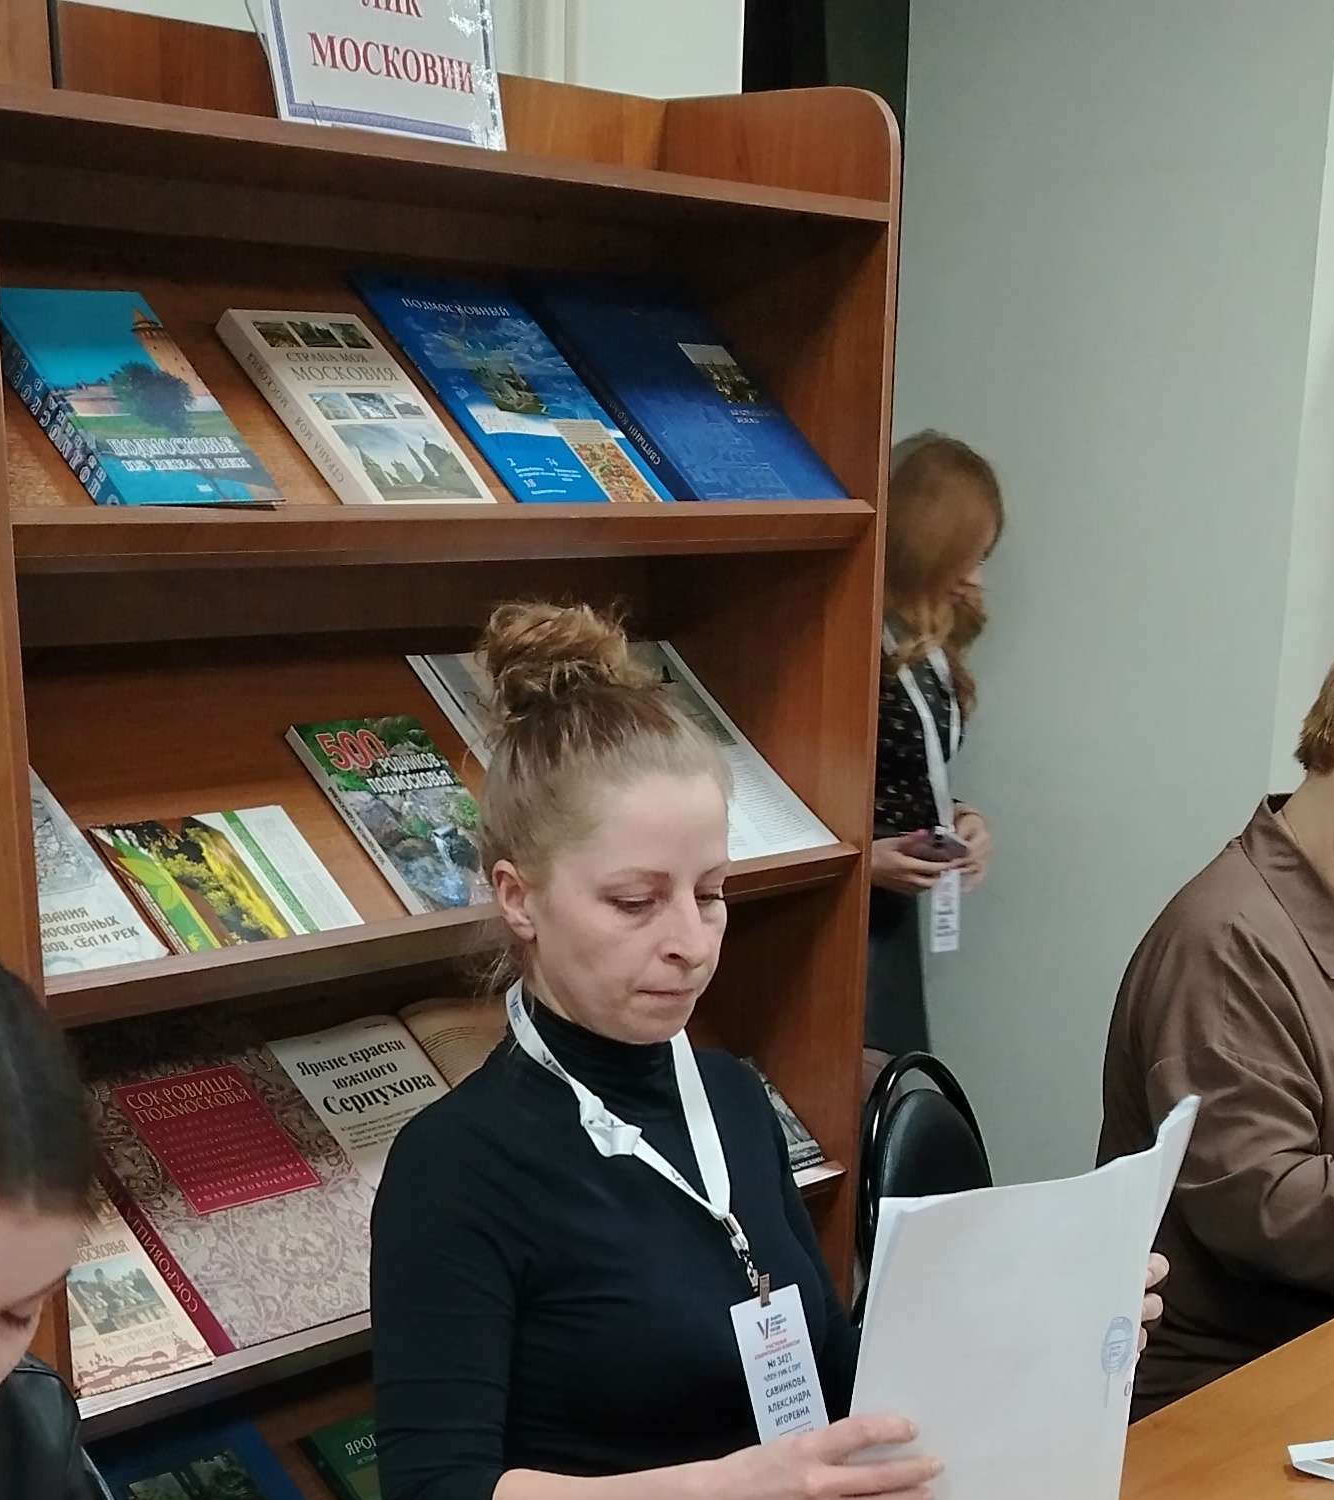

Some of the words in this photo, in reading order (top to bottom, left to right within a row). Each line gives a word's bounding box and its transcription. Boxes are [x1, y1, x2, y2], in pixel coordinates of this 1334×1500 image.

[308, 32, 475, 94] МОСКОВИИ
[286, 351, 338, 364] СТРАНА
[341, 353, 369, 364] МОЯ
[291, 366, 400, 382] МОСКОВИЯ
[315, 728, 390, 771] 500
[378, 751, 441, 774] РОДНИКОВ
[366, 770, 455, 795] ПОДМОСКОВЬЯ
[74, 933, 98, 950] СЁЛ
[101, 933, 110, 946] И
[111, 926, 140, 943] РЕК
[296, 1055, 349, 1077] Яркие
[351, 1039, 406, 1064] краски
[332, 1062, 398, 1089] южного
[126, 1075, 243, 1110] СОКРОВИЩА
[323, 1073, 437, 1116] Серпухова
[135, 1090, 252, 1124] ПОДМОСКОВЬЯ
[765, 1375, 807, 1398] САВИНКОВА
[768, 1389, 812, 1414] АЛЕКСАНДРА
[774, 1406, 811, 1427] ИГОРЕВНА
